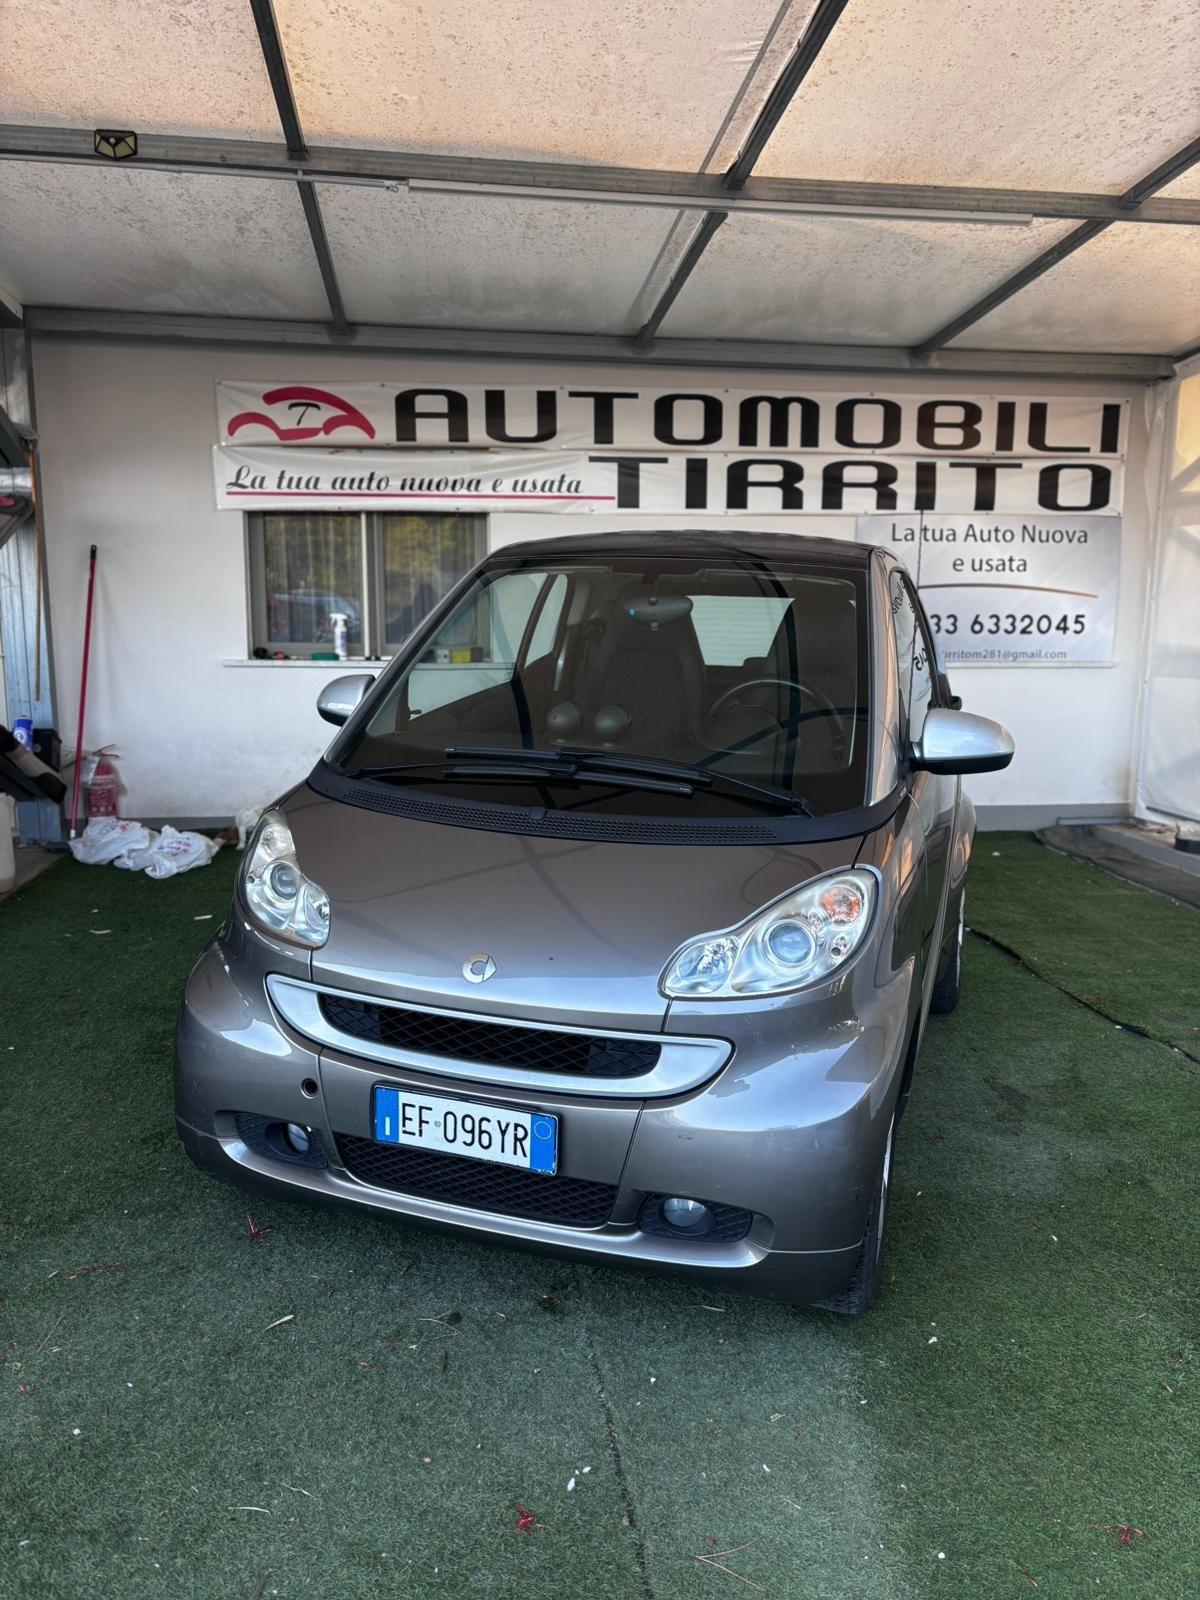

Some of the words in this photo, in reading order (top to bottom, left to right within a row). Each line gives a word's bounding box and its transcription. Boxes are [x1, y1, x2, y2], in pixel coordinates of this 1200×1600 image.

[394, 388, 1121, 453] AUTOMOBILI
[226, 464, 268, 489] La
[276, 469, 322, 490] tua
[331, 471, 392, 491] auto
[400, 477, 483, 493] nuova
[491, 477, 504, 493] e
[512, 473, 583, 494] usata
[588, 456, 1112, 512] TIRRITO
[891, 522, 915, 543] La
[920, 523, 957, 543] tua
[963, 523, 1015, 543] Auto
[1021, 524, 1088, 544] Nuova
[952, 557, 965, 573] e
[971, 556, 1028, 573] usata
[970, 613, 1086, 635] 6332045
[942, 649, 1068, 661] irritom281@gmail.com
